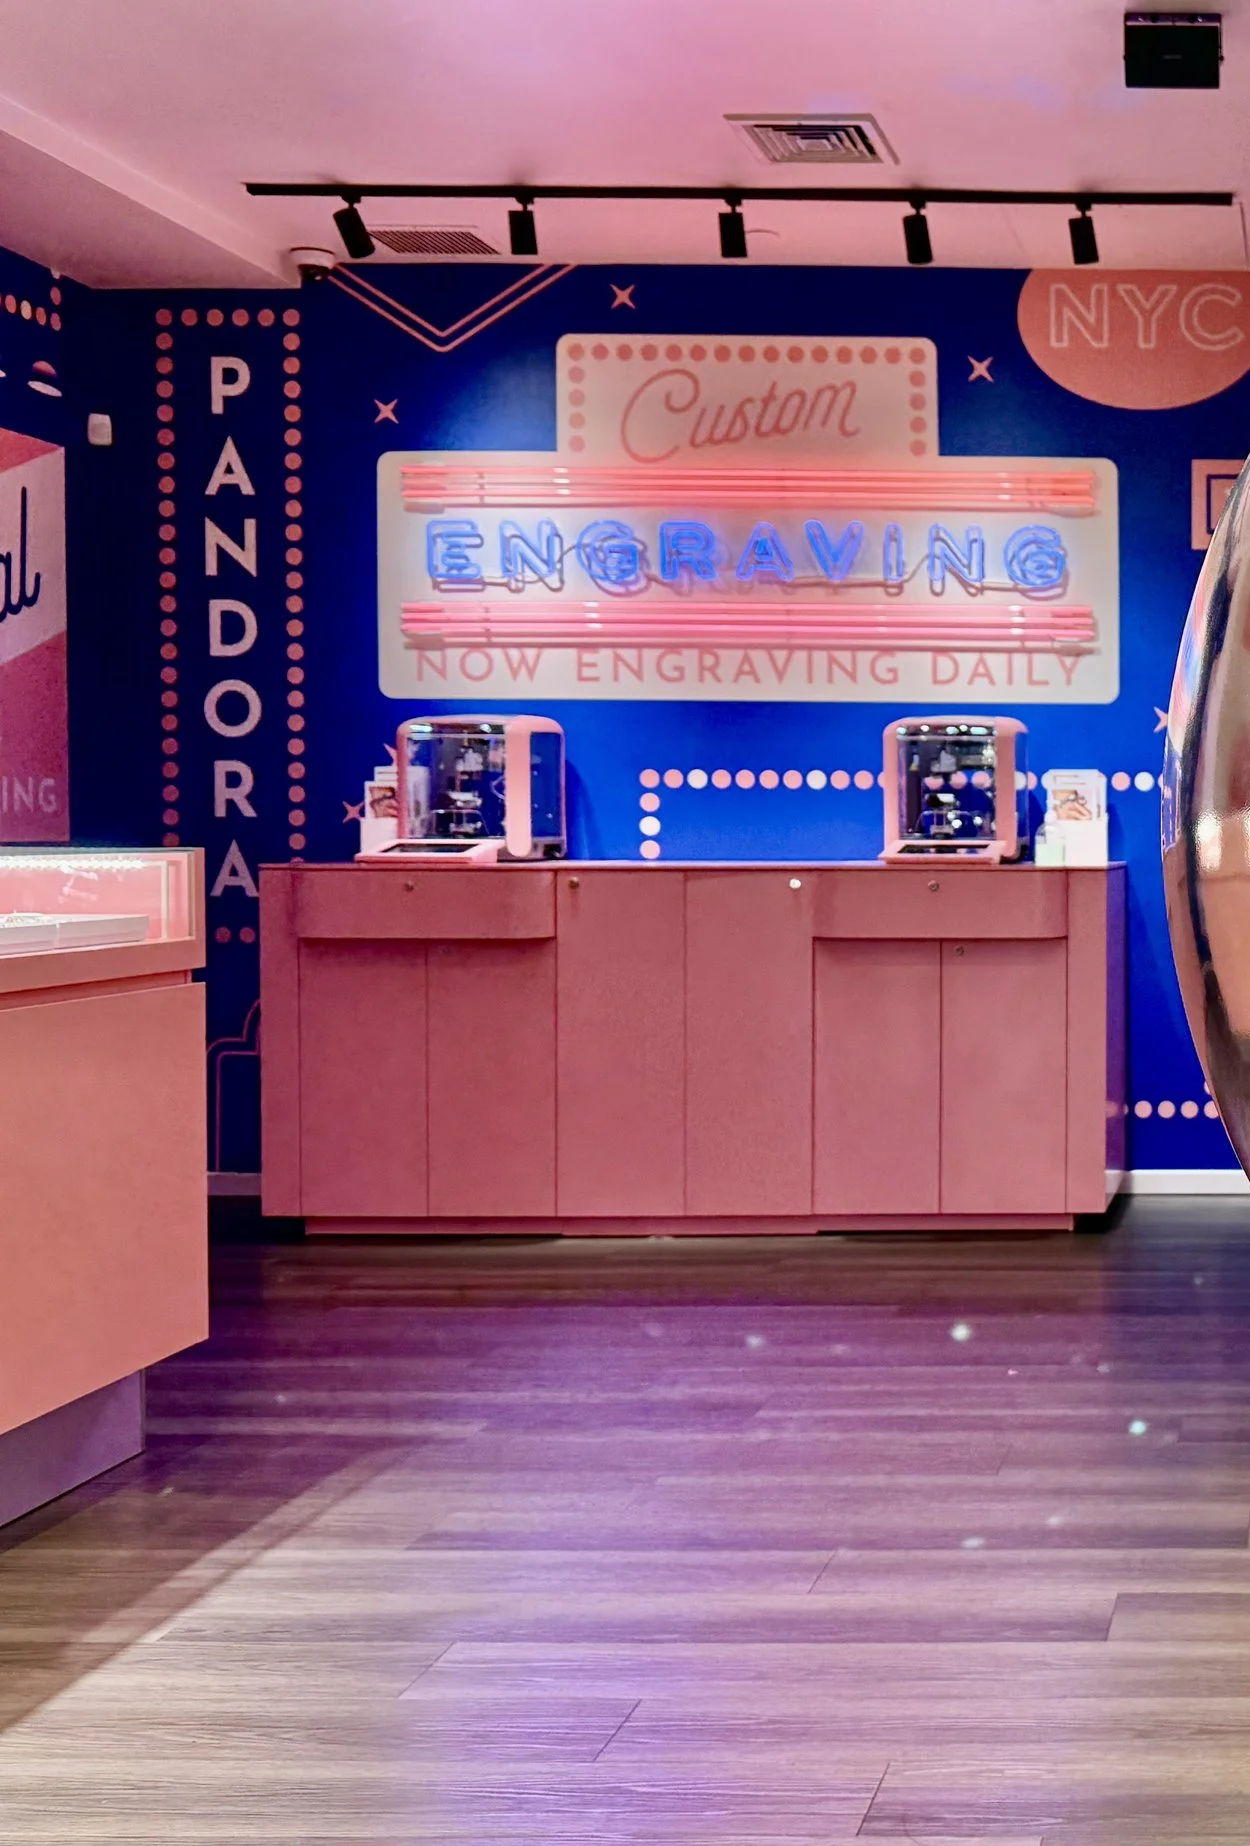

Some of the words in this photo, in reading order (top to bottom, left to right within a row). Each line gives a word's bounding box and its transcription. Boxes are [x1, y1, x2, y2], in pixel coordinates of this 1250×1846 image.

[1050, 283, 1244, 351] NYC
[620, 368, 861, 464] Custom
[426, 518, 1066, 589] ENGRAVING
[203, 355, 262, 898] PANDORA
[416, 646, 542, 683] NOW
[576, 647, 900, 686] ENGRAVING
[930, 650, 1082, 687] DAILY
